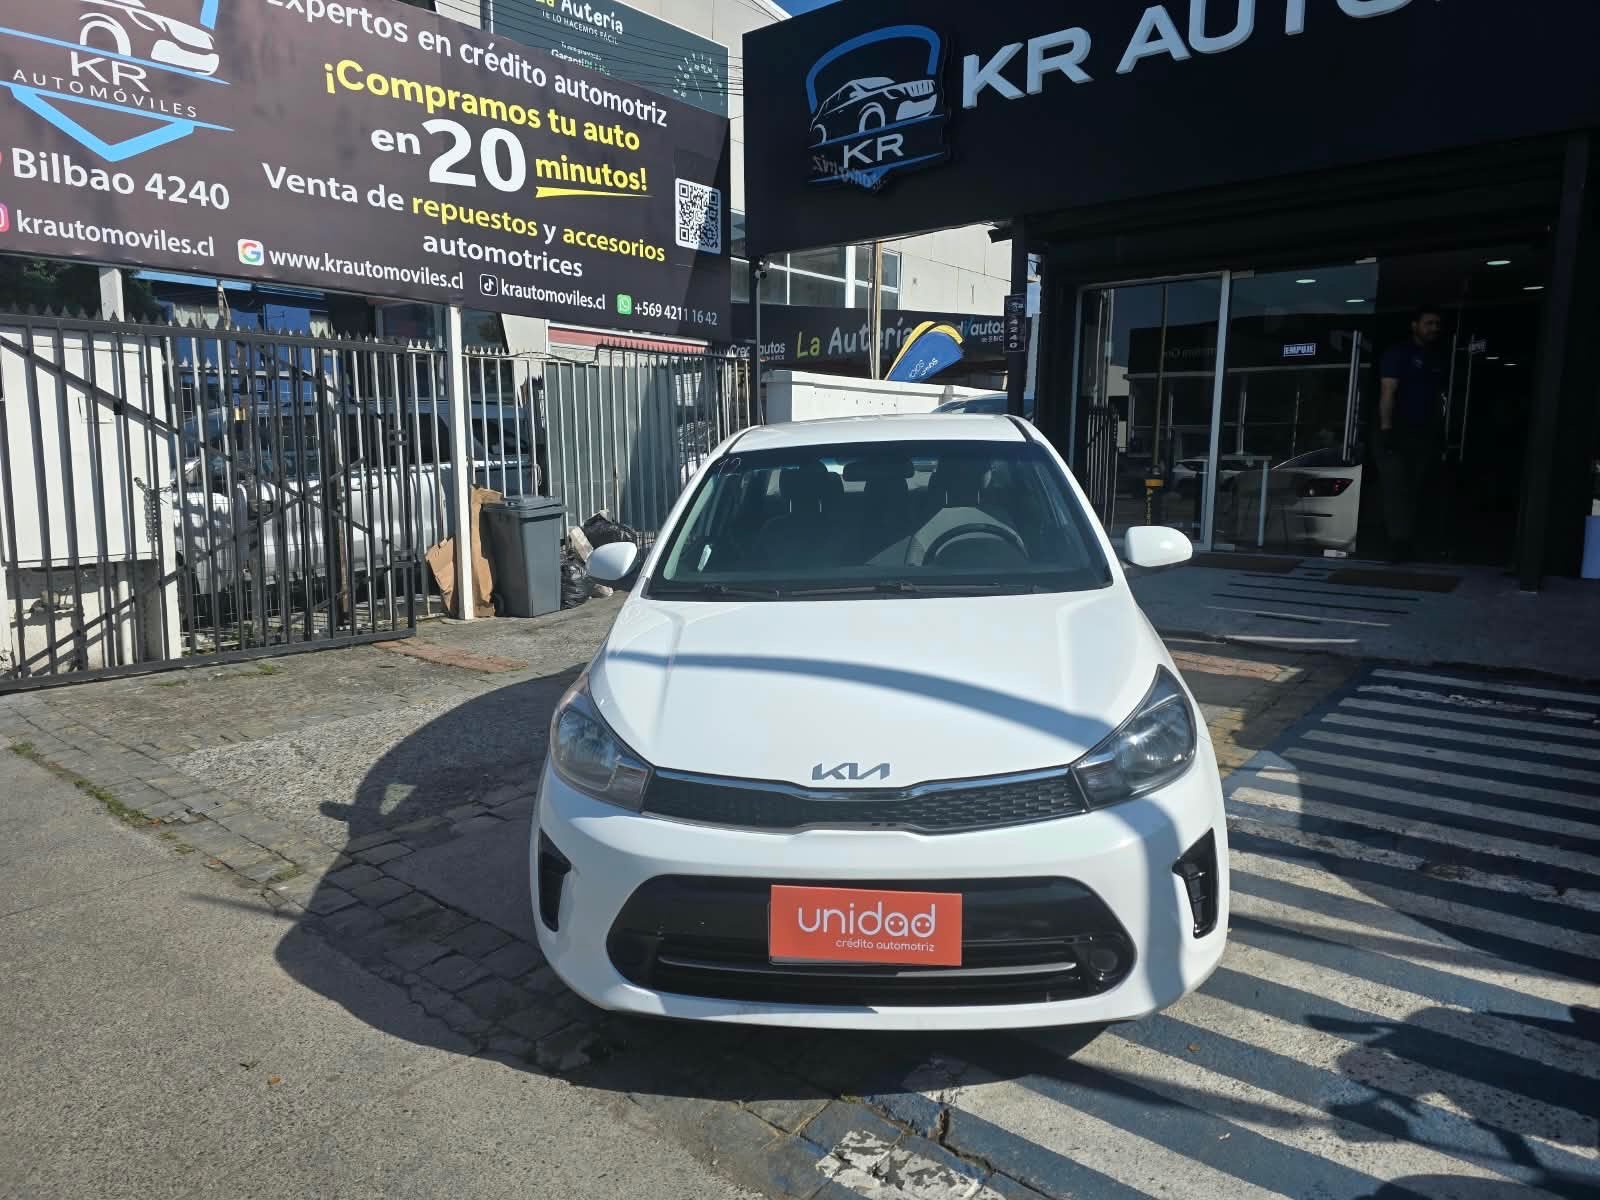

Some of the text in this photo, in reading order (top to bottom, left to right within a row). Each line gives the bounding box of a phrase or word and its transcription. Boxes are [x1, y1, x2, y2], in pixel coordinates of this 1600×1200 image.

[561, 0, 623, 35] Autería
[70, 51, 151, 93] KR
[266, 0, 409, 43] xpertos
[418, 30, 452, 56] en
[459, 41, 546, 87] crédito
[554, 74, 668, 127] automotriz
[962, 27, 1095, 109] KR
[12, 68, 198, 119] AUTOMÓVILES
[324, 58, 640, 151] ¡Compramos tu auto
[370, 118, 648, 193] en 20 minutos!
[843, 133, 904, 169] KR
[11, 148, 231, 211] Bilbao 4240
[16, 209, 215, 257] krautomoviles.cl
[261, 162, 666, 263] Venta de repuestos y accesorios
[268, 249, 464, 290] www.krautomoviles.cl
[422, 235, 583, 278] automotrices
[500, 278, 606, 311] krautomoviles.cl
[634, 301, 662, 317] +569
[664, 304, 688, 321] 4211
[796, 331, 820, 358] La
[797, 901, 936, 938] unidad
[835, 938, 935, 952] crédito automotriz
